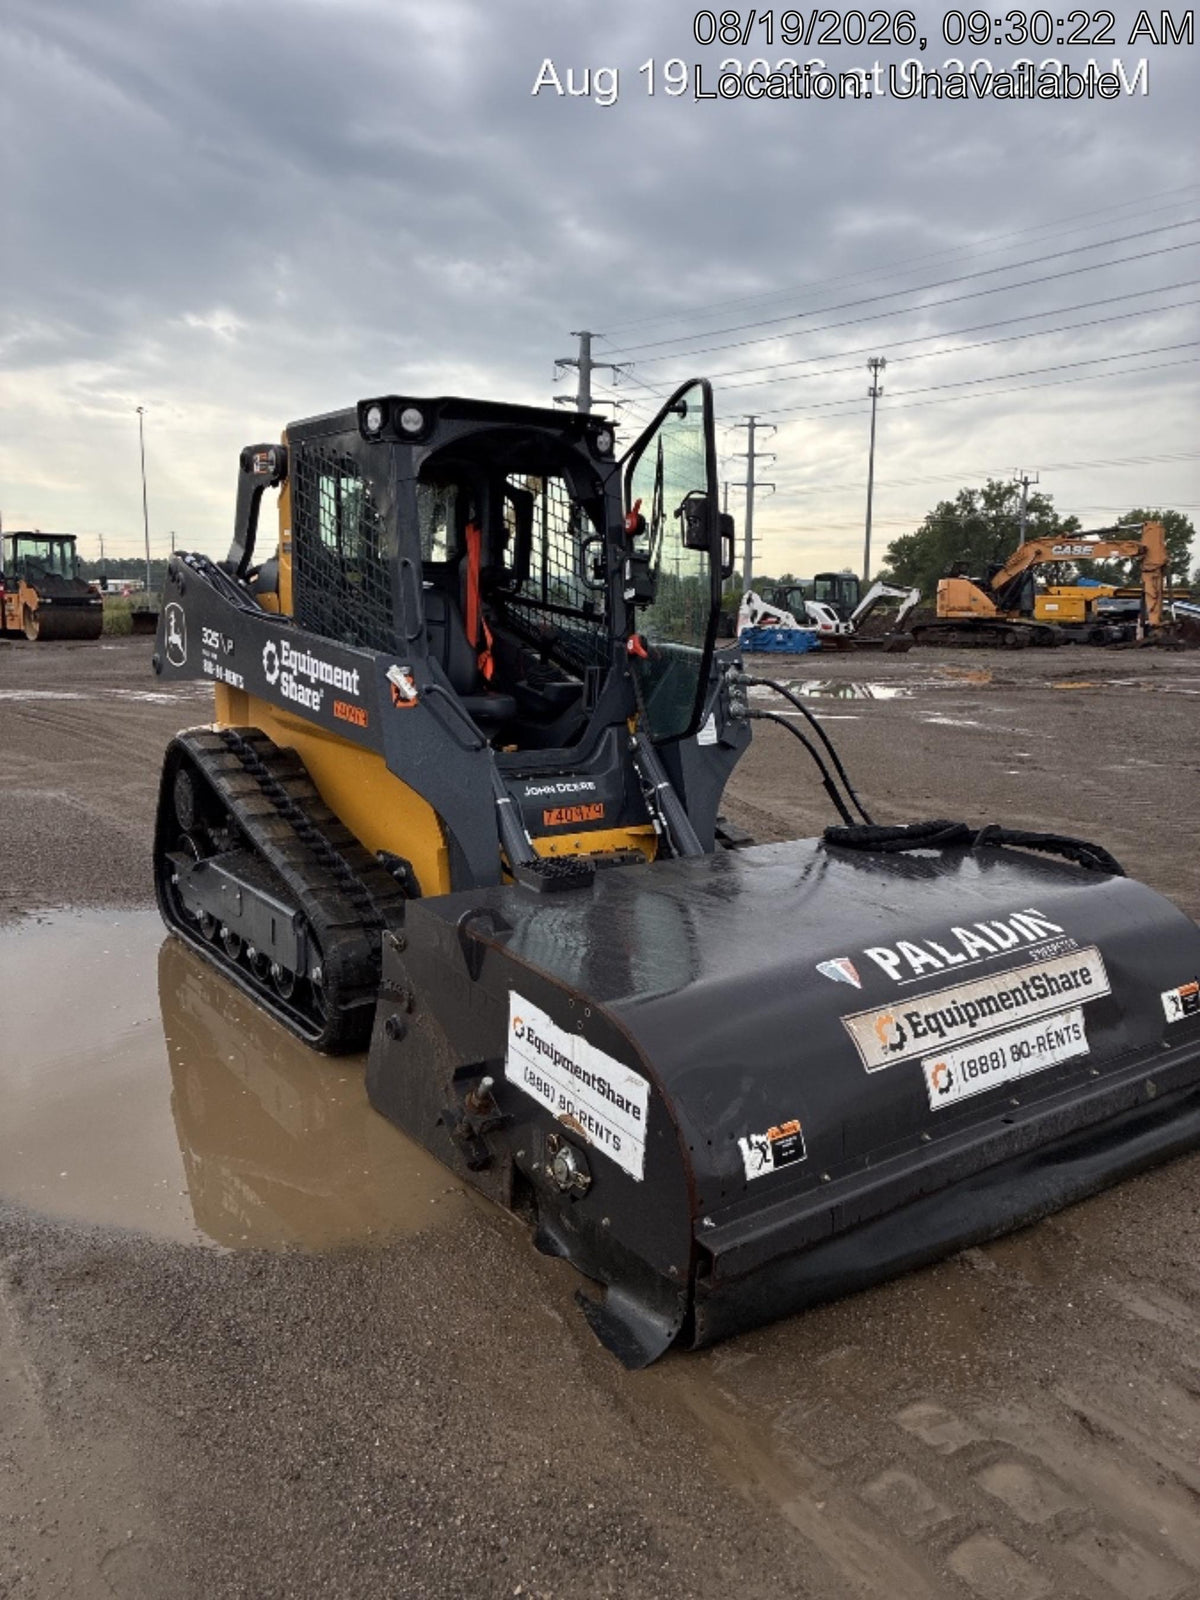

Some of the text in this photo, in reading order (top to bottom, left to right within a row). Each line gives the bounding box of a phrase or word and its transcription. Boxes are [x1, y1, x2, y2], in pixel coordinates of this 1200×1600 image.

[1052, 545, 1094, 555] CASE
[281, 640, 360, 696] Equipment
[524, 782, 596, 797] JOHN DEERE
[864, 908, 1065, 981] PALADIN
[904, 966, 1093, 1039] EquipmentShare
[526, 1027, 641, 1121] EquipmentShare
[960, 1023, 1082, 1082] (888) 80-RENTS
[523, 1065, 622, 1152] (888) 80-RENTS
